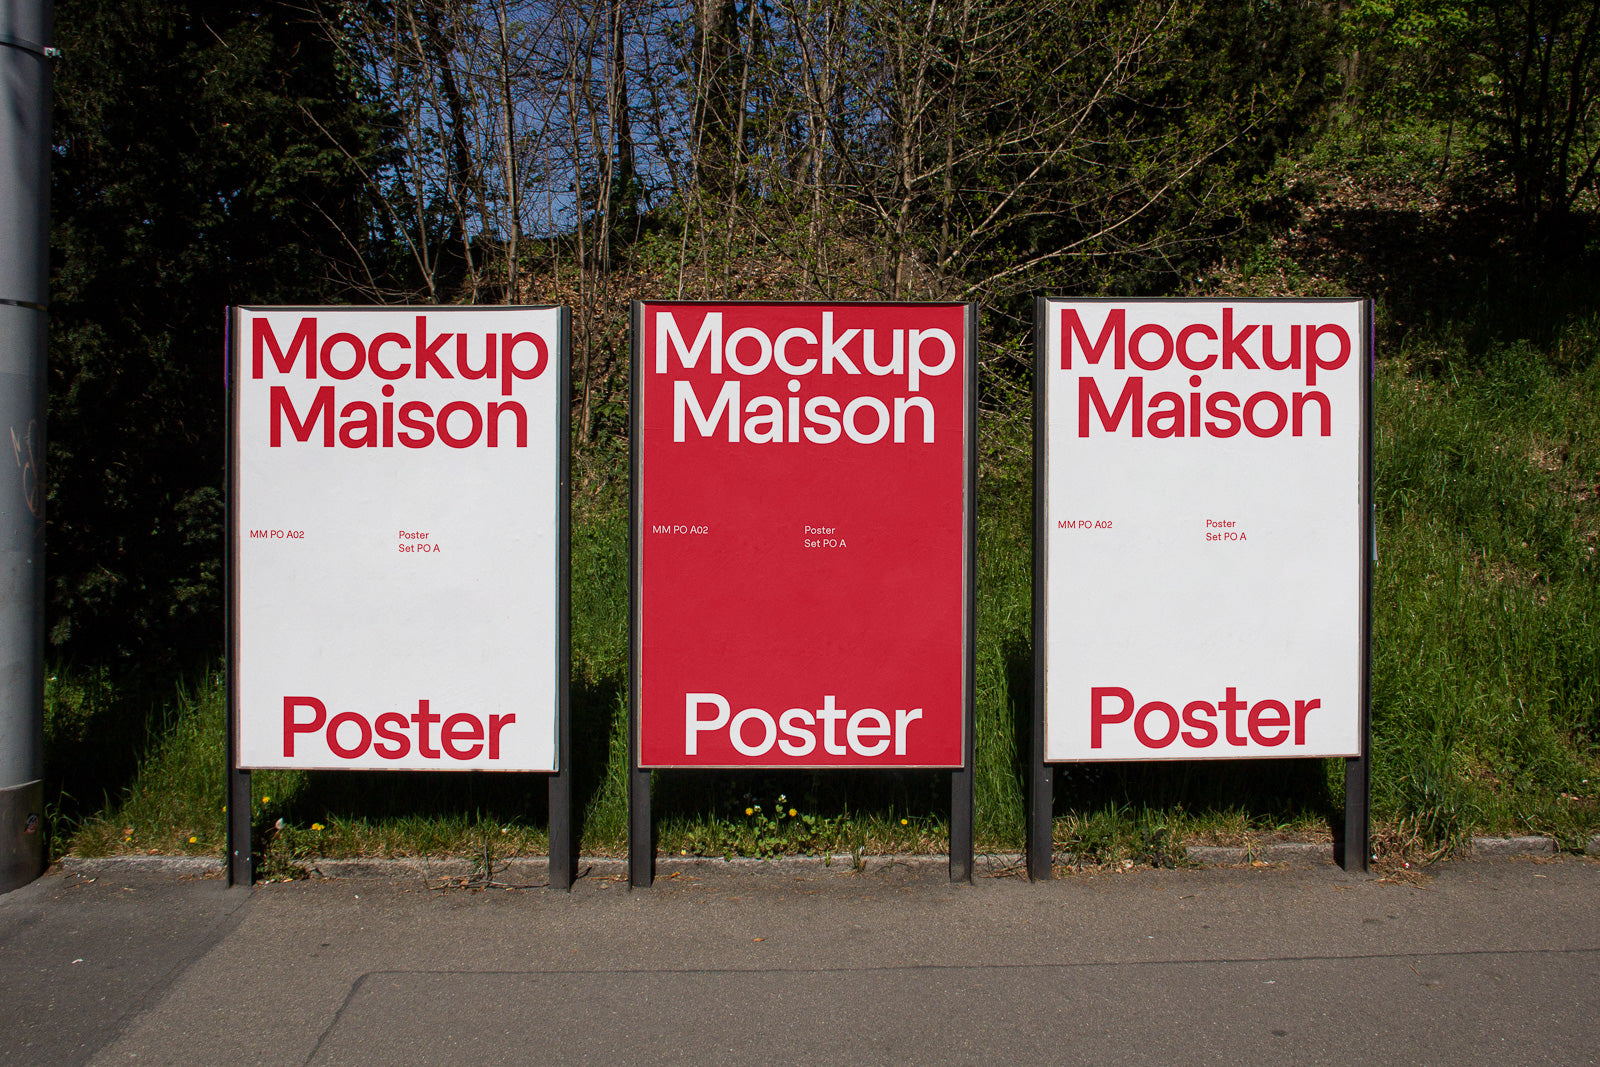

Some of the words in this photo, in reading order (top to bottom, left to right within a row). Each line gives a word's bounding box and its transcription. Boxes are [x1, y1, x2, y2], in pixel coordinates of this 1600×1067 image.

[252, 316, 548, 397] Mockup
[656, 311, 955, 392] Mockup
[1060, 308, 1352, 387] Mockup
[270, 384, 528, 449] Maison
[674, 379, 935, 444] Maison
[1078, 375, 1332, 438] Maison
[249, 529, 268, 539] MM
[270, 529, 284, 539] PO
[286, 529, 305, 539] A02
[398, 530, 430, 540] Poster
[652, 525, 671, 534] MM
[673, 525, 688, 534] PO
[690, 525, 709, 535] A02
[804, 525, 836, 535] Poster
[1057, 520, 1076, 529] MM
[1078, 520, 1093, 529] PO
[1094, 520, 1113, 529] A02
[1205, 532, 1222, 541] Set
[1224, 532, 1238, 541] PO
[1239, 532, 1247, 541] A
[1206, 519, 1236, 528] Poster
[398, 543, 415, 553] Set
[417, 543, 431, 553] PO
[433, 543, 441, 553] A
[804, 538, 821, 548] Set
[823, 538, 837, 548] PO
[839, 538, 847, 548] A
[283, 696, 517, 760] Poster
[686, 693, 923, 756] Poster
[1091, 687, 1322, 749] Poster
